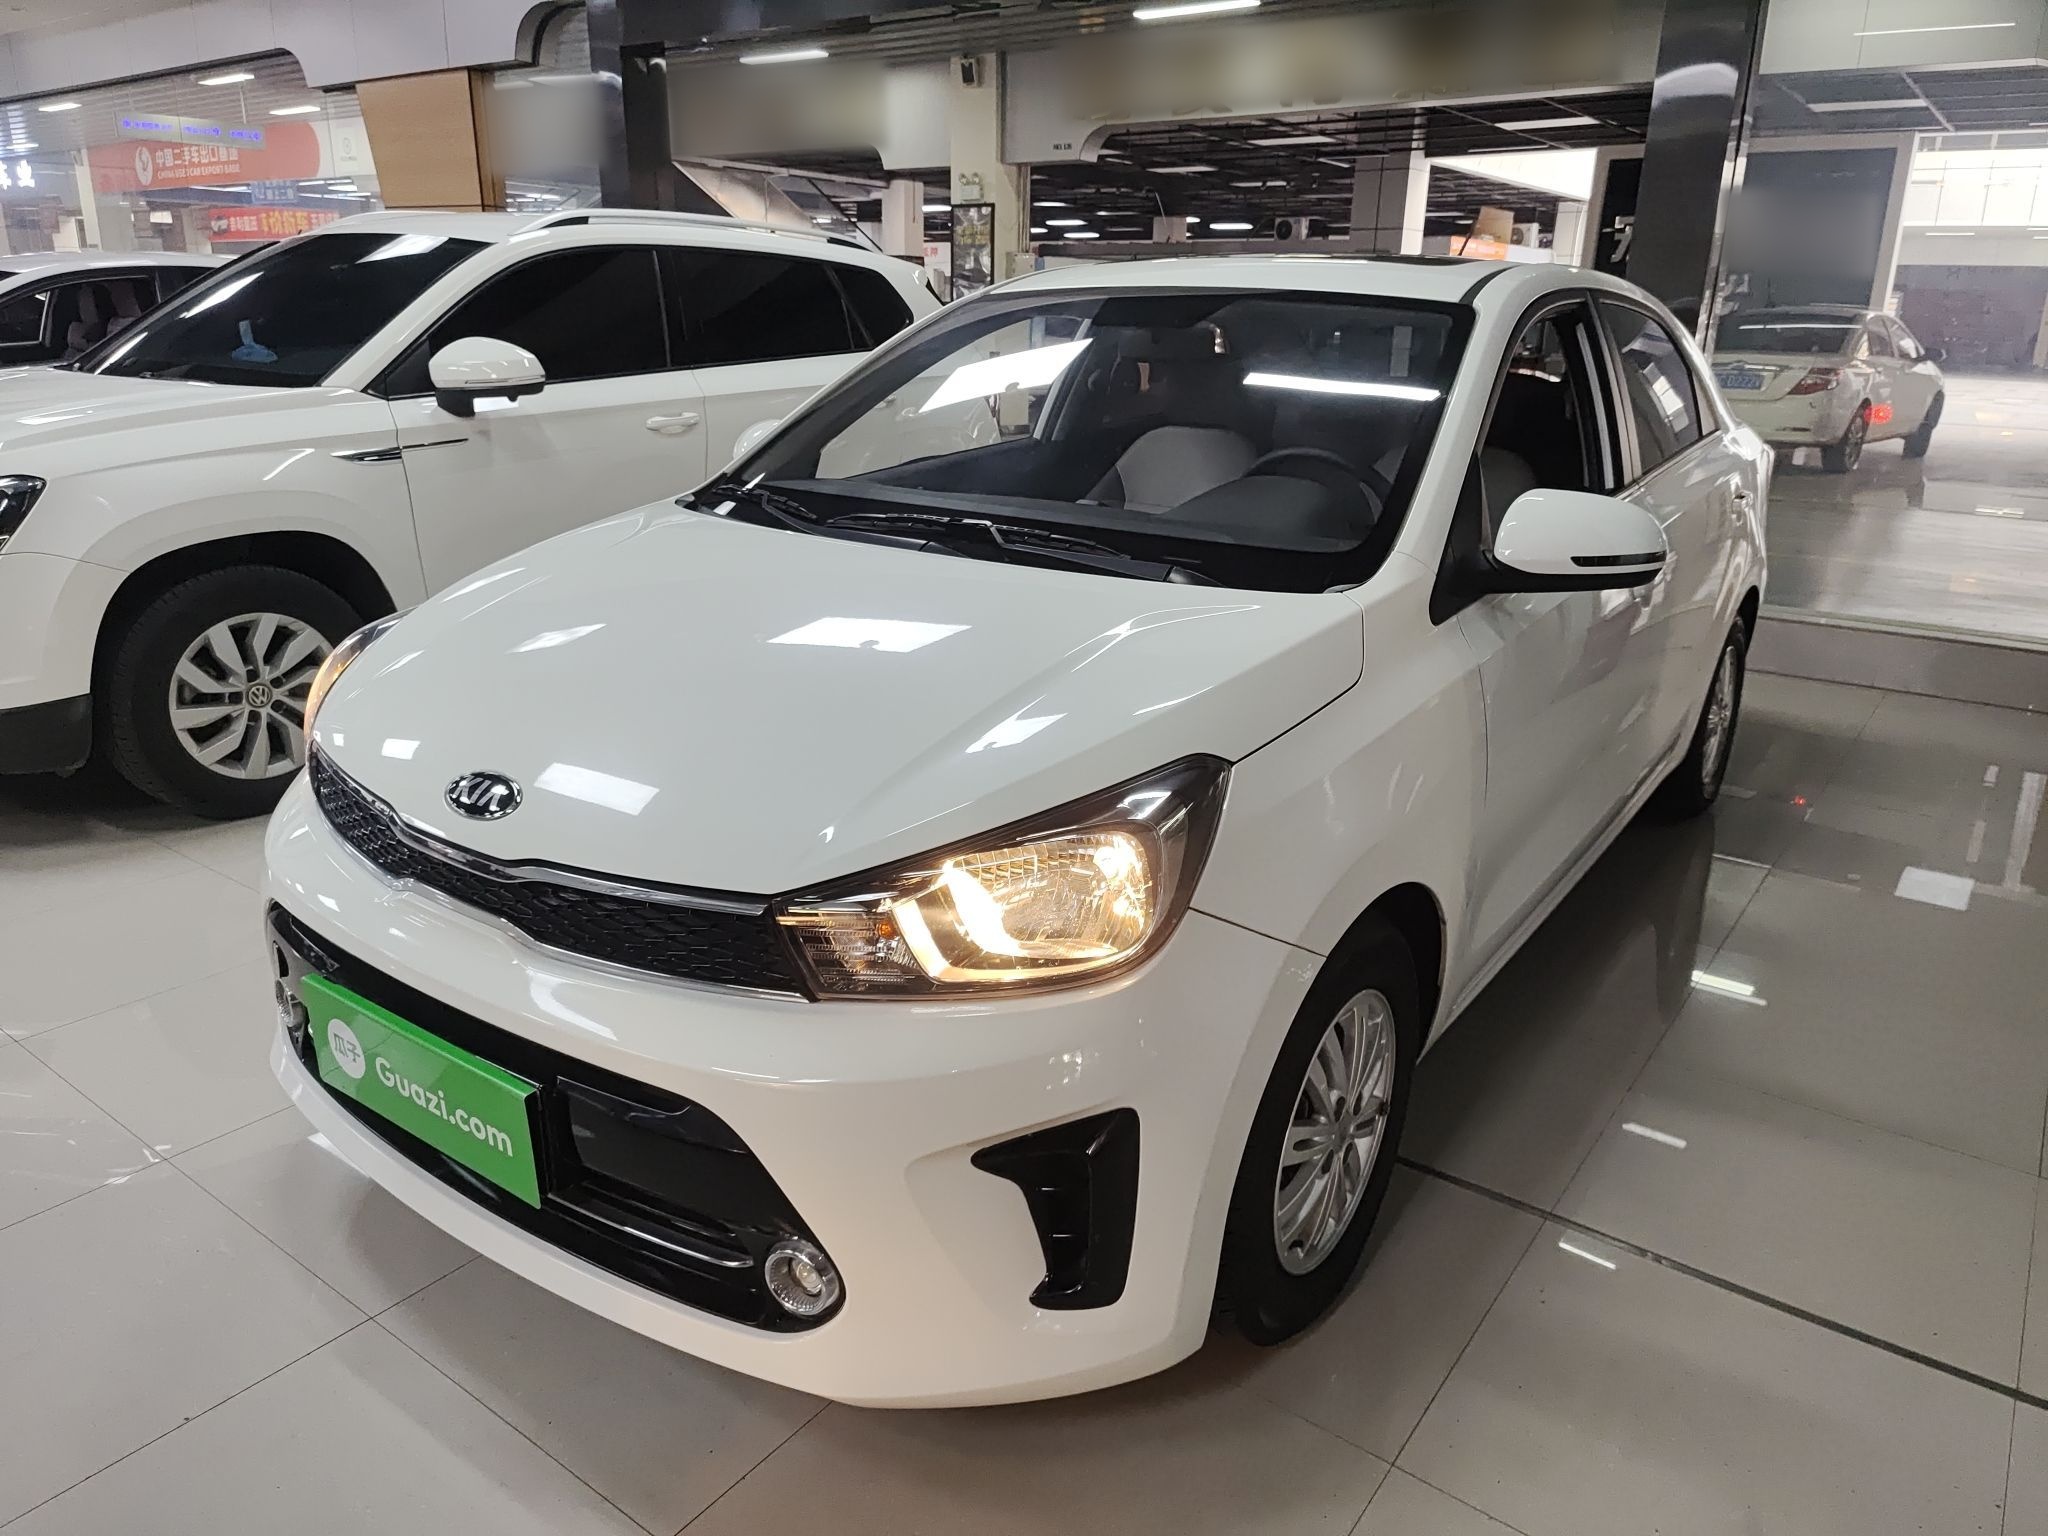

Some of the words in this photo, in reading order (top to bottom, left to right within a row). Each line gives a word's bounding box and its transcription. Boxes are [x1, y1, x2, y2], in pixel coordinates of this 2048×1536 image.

[451, 776, 510, 812] KIA
[333, 1032, 361, 1063] 瓜子
[375, 1056, 514, 1158] Guazi.com
